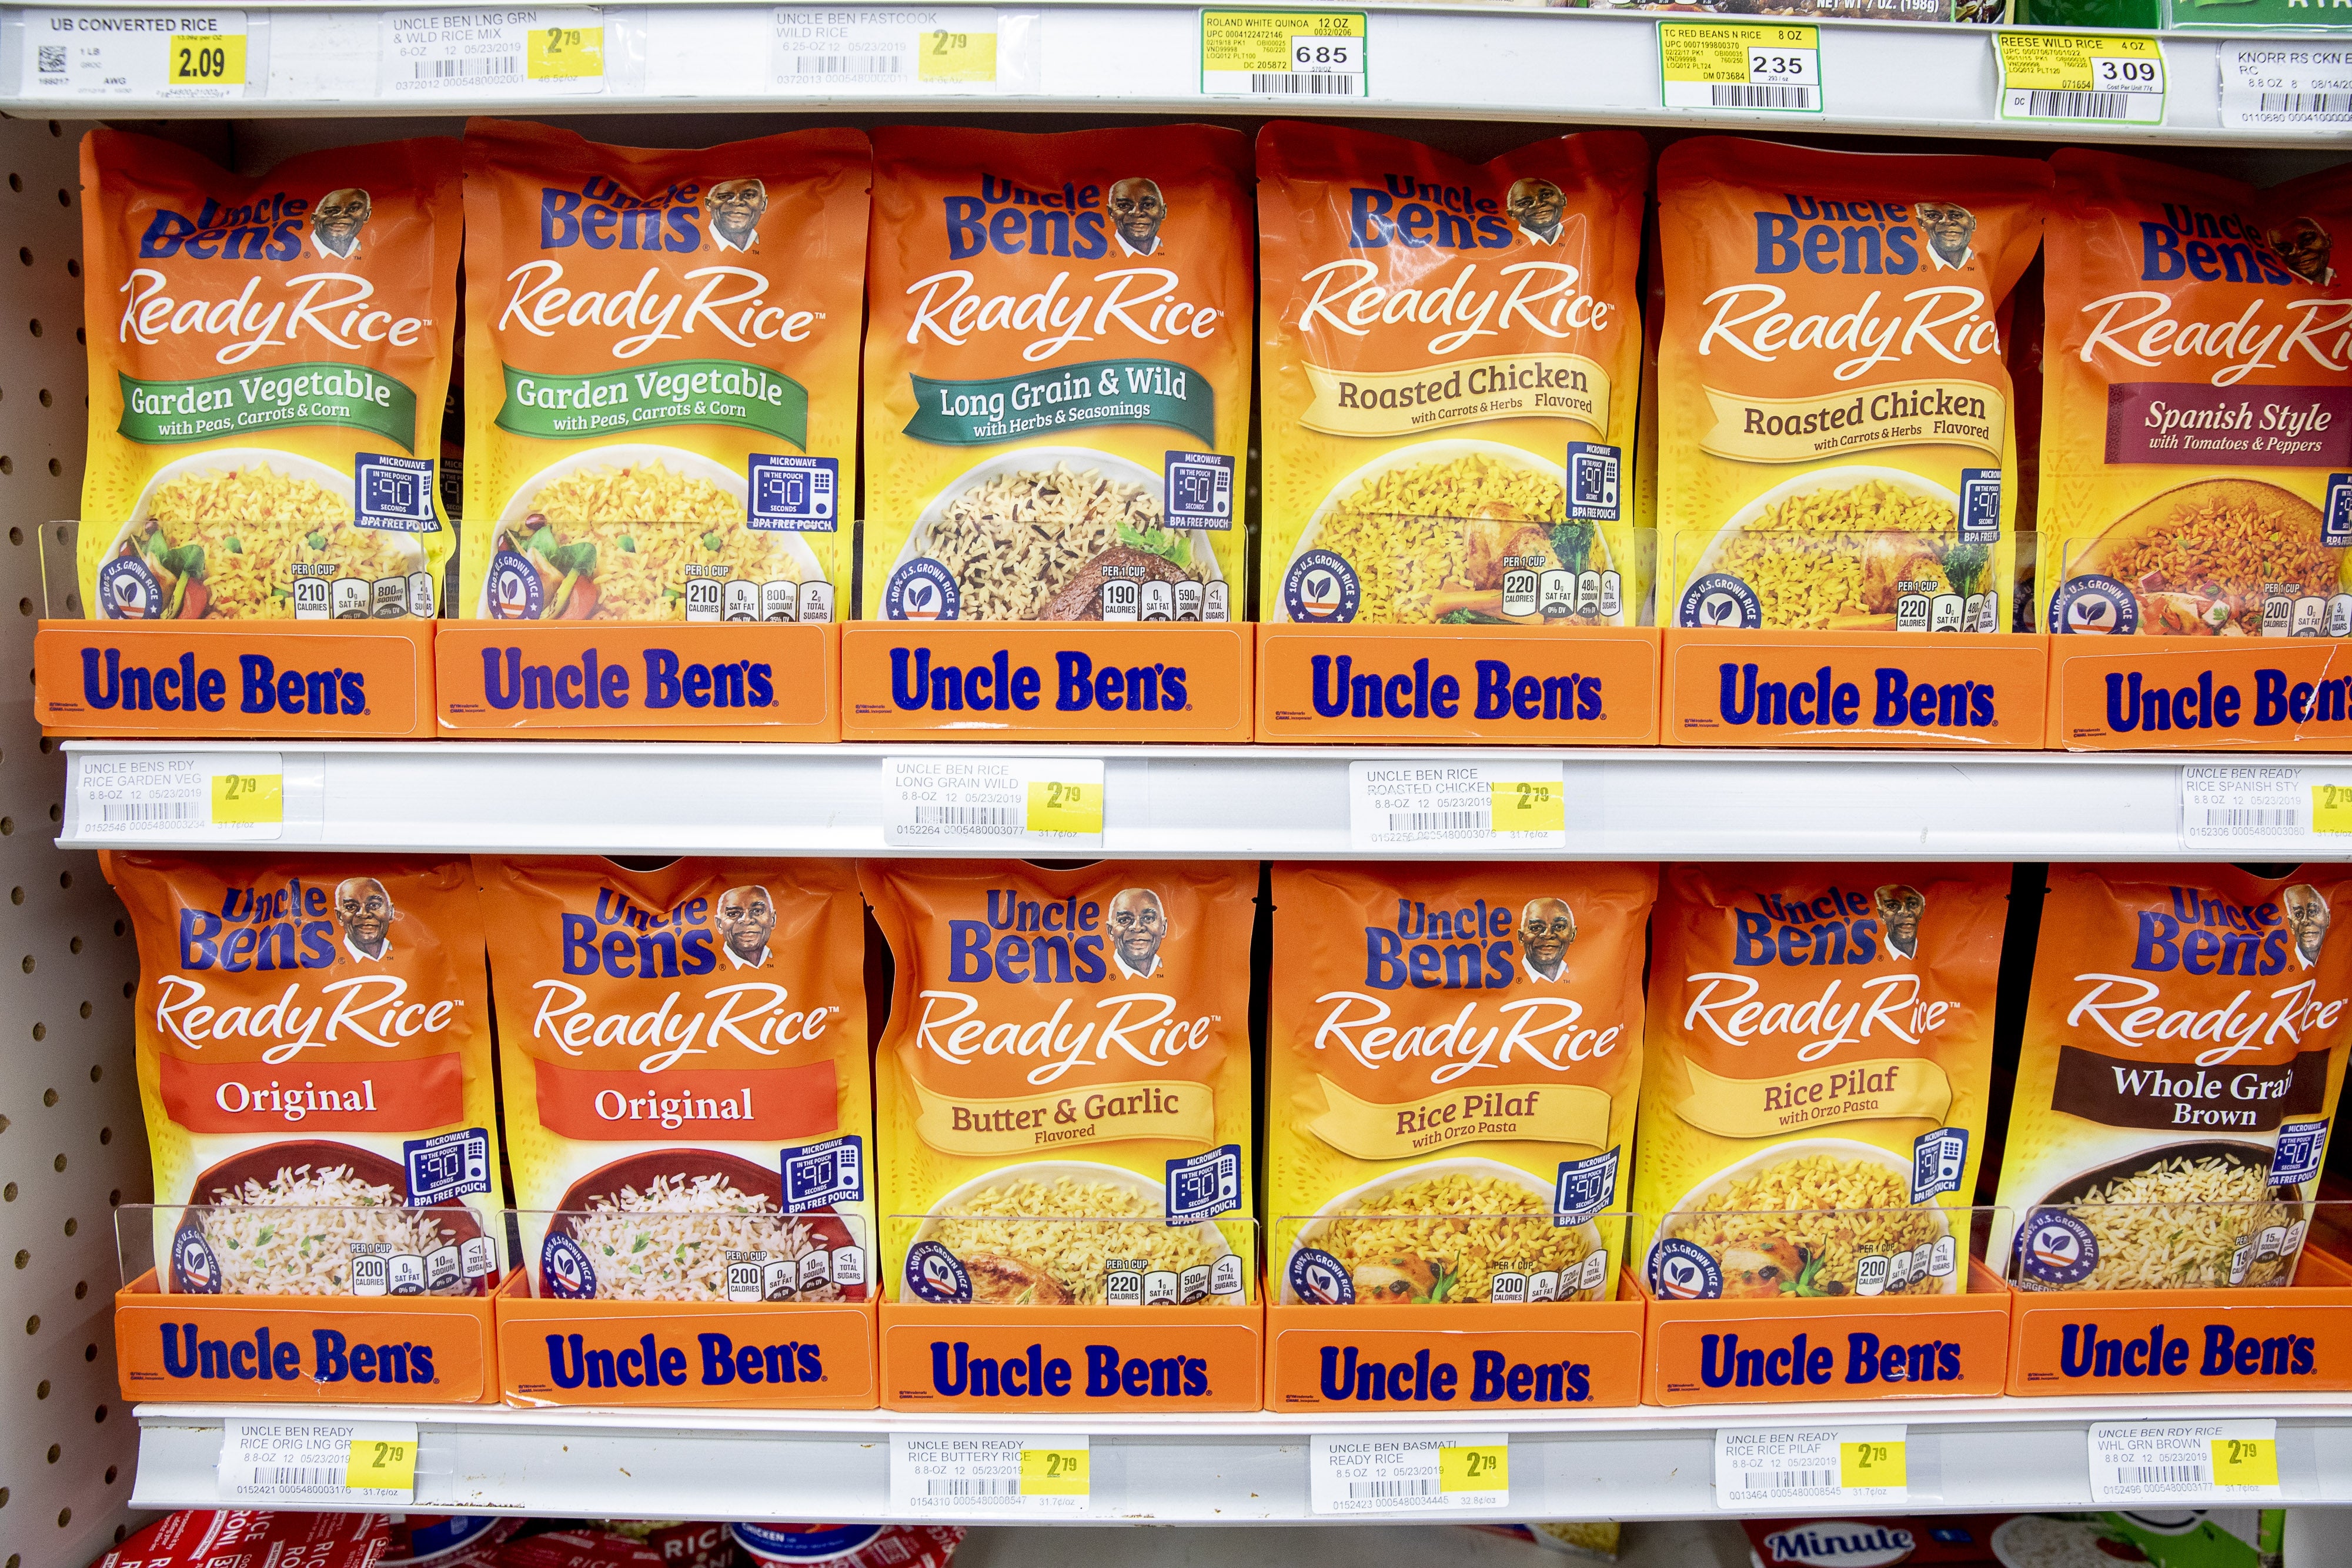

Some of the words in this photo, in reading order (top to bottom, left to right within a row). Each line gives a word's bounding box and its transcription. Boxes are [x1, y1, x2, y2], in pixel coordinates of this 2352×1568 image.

[51, 18, 74, 31] UB
[79, 18, 176, 31] CONVERTED
[182, 19, 217, 31] RICE
[394, 18, 439, 30] UNCLE
[443, 16, 470, 28] BEN
[476, 14, 503, 26] LNG
[507, 12, 537, 25] GRN
[777, 14, 823, 24] UNCLE
[828, 14, 856, 24] BEN
[861, 13, 937, 24] FASTCOOK
[1319, 19, 1330, 28] 12
[1334, 19, 1348, 28] OZ
[394, 35, 402, 44] &
[406, 32, 436, 42] WLD
[442, 30, 473, 41] RICE
[478, 29, 501, 39] MIX
[777, 28, 811, 38] WILD
[816, 28, 848, 38] RICE
[1779, 31, 1784, 40] 8
[1788, 32, 1802, 40] OZ
[2002, 37, 2040, 46] REESE
[2044, 39, 2072, 48] WILD
[2077, 40, 2103, 48] RICE
[179, 48, 225, 77] 2.09
[400, 47, 427, 56] 6-OZ
[445, 46, 456, 55] 12
[465, 43, 521, 54] 05/23/2019
[2239, 52, 2286, 63] KNORR
[2291, 53, 2308, 63] RS
[2313, 53, 2341, 63] CKN
[982, 173, 1100, 208] Uncle
[943, 196, 1108, 260] Ben's
[906, 270, 1094, 362] Ready
[1094, 268, 1217, 345] Rice
[132, 386, 233, 415] Garden
[239, 370, 391, 407] Vegetable
[516, 379, 628, 411] Garden
[635, 367, 782, 406] Vegetable
[940, 389, 1005, 420] Long
[1011, 373, 1091, 412] Grain
[1098, 368, 1120, 394] &
[1125, 367, 1187, 400] Wild
[1338, 371, 1461, 409] Roasted
[1468, 362, 1588, 394] Chicken
[159, 420, 193, 436] with
[196, 417, 234, 433] Peas,
[238, 407, 295, 426] Carrots
[298, 404, 308, 417] &
[311, 403, 350, 417] Corn
[974, 420, 1008, 437] with
[1010, 414, 1052, 433] Herbs
[1055, 412, 1065, 424] &
[1068, 402, 1150, 423] Seasonings
[1411, 411, 1436, 424] with
[1438, 403, 1478, 419] Carrots
[1480, 403, 1488, 412] &
[1490, 397, 1522, 412] Herbs
[1535, 393, 1592, 413] Flavored
[1744, 397, 1863, 435] Roasted
[1871, 389, 1986, 420] Chicken
[2145, 401, 2251, 434] Spanish
[2259, 403, 2331, 437] Style
[2149, 435, 2178, 449] with
[2183, 436, 2249, 451] Tomatoes
[2251, 437, 2264, 450] &
[2266, 439, 2322, 454] Peppers
[1170, 516, 1185, 527] BPA
[1187, 517, 1204, 527] FREE
[1204, 517, 1228, 529] POUCH
[690, 586, 718, 603] 210
[689, 604, 719, 613] CALORIES
[81, 648, 226, 711] Uncle
[240, 654, 365, 715] Ben's
[890, 647, 1040, 711] Uncle
[1055, 651, 1186, 711] Ben's
[1719, 663, 1860, 726] Uncle
[1875, 668, 1994, 727] Ben's
[83, 777, 113, 787] RICE
[118, 775, 171, 785] GARDEN
[176, 774, 201, 783] VEG
[85, 763, 126, 774] UNCLE
[131, 762, 165, 773] BENS
[169, 761, 194, 771] RDY
[1368, 771, 1411, 781] UNCLE
[1416, 770, 1442, 780] BEN
[1448, 768, 1478, 779] RICE
[896, 777, 933, 787] LONG
[938, 778, 980, 788] GRAIN
[985, 778, 1018, 788] WILD
[2187, 782, 2215, 791] RICE
[2219, 782, 2271, 791] SPANISH
[2276, 782, 2298, 791] STY
[987, 890, 1100, 931] Uncle
[948, 920, 1107, 984] Ben's
[917, 990, 1096, 1085] Ready
[1096, 992, 1209, 1066] Rice
[2112, 1066, 2222, 1098] Whole
[2230, 1069, 2293, 1100] Grai
[216, 1080, 377, 1122] Original
[594, 1088, 754, 1131] Original
[952, 1105, 1047, 1132] Butter
[1054, 1099, 1077, 1125] &
[1084, 1088, 1179, 1118] Garlic
[1396, 1102, 1456, 1135] Rice
[1463, 1091, 1540, 1119] Pilaf
[2172, 1103, 2256, 1125] Brown
[1034, 1124, 1095, 1145] Flavored
[1412, 1131, 1442, 1148] with
[1445, 1126, 1475, 1141] Orzo
[1478, 1121, 1516, 1134] Pasta
[160, 1323, 300, 1380] Uncle
[313, 1329, 433, 1384] Ben's
[1320, 1346, 1458, 1400] Uncle
[1470, 1350, 1590, 1402] Ben's
[240, 1439, 269, 1449] RICE
[273, 1439, 302, 1449] ORIG
[307, 1440, 330, 1449] LNG
[335, 1440, 352, 1449] GR
[909, 1452, 937, 1462] RICE
[941, 1452, 998, 1462] BUTTERY
[1003, 1452, 1031, 1461] RICE
[1330, 1444, 1370, 1453] UNCLE
[1375, 1443, 1399, 1452] BEN
[1404, 1440, 1456, 1449] BASMATI
[1726, 1446, 1753, 1456] RICE
[1758, 1445, 1785, 1454] RICE
[1789, 1444, 1820, 1453] PILAF
[2098, 1441, 2124, 1450] WHL
[2127, 1440, 2153, 1449] GRN
[2157, 1439, 2200, 1448] BROWN
[1330, 1455, 1371, 1465] READY
[1376, 1454, 1404, 1463] RICE
[1769, 1529, 1912, 1557] Minute
